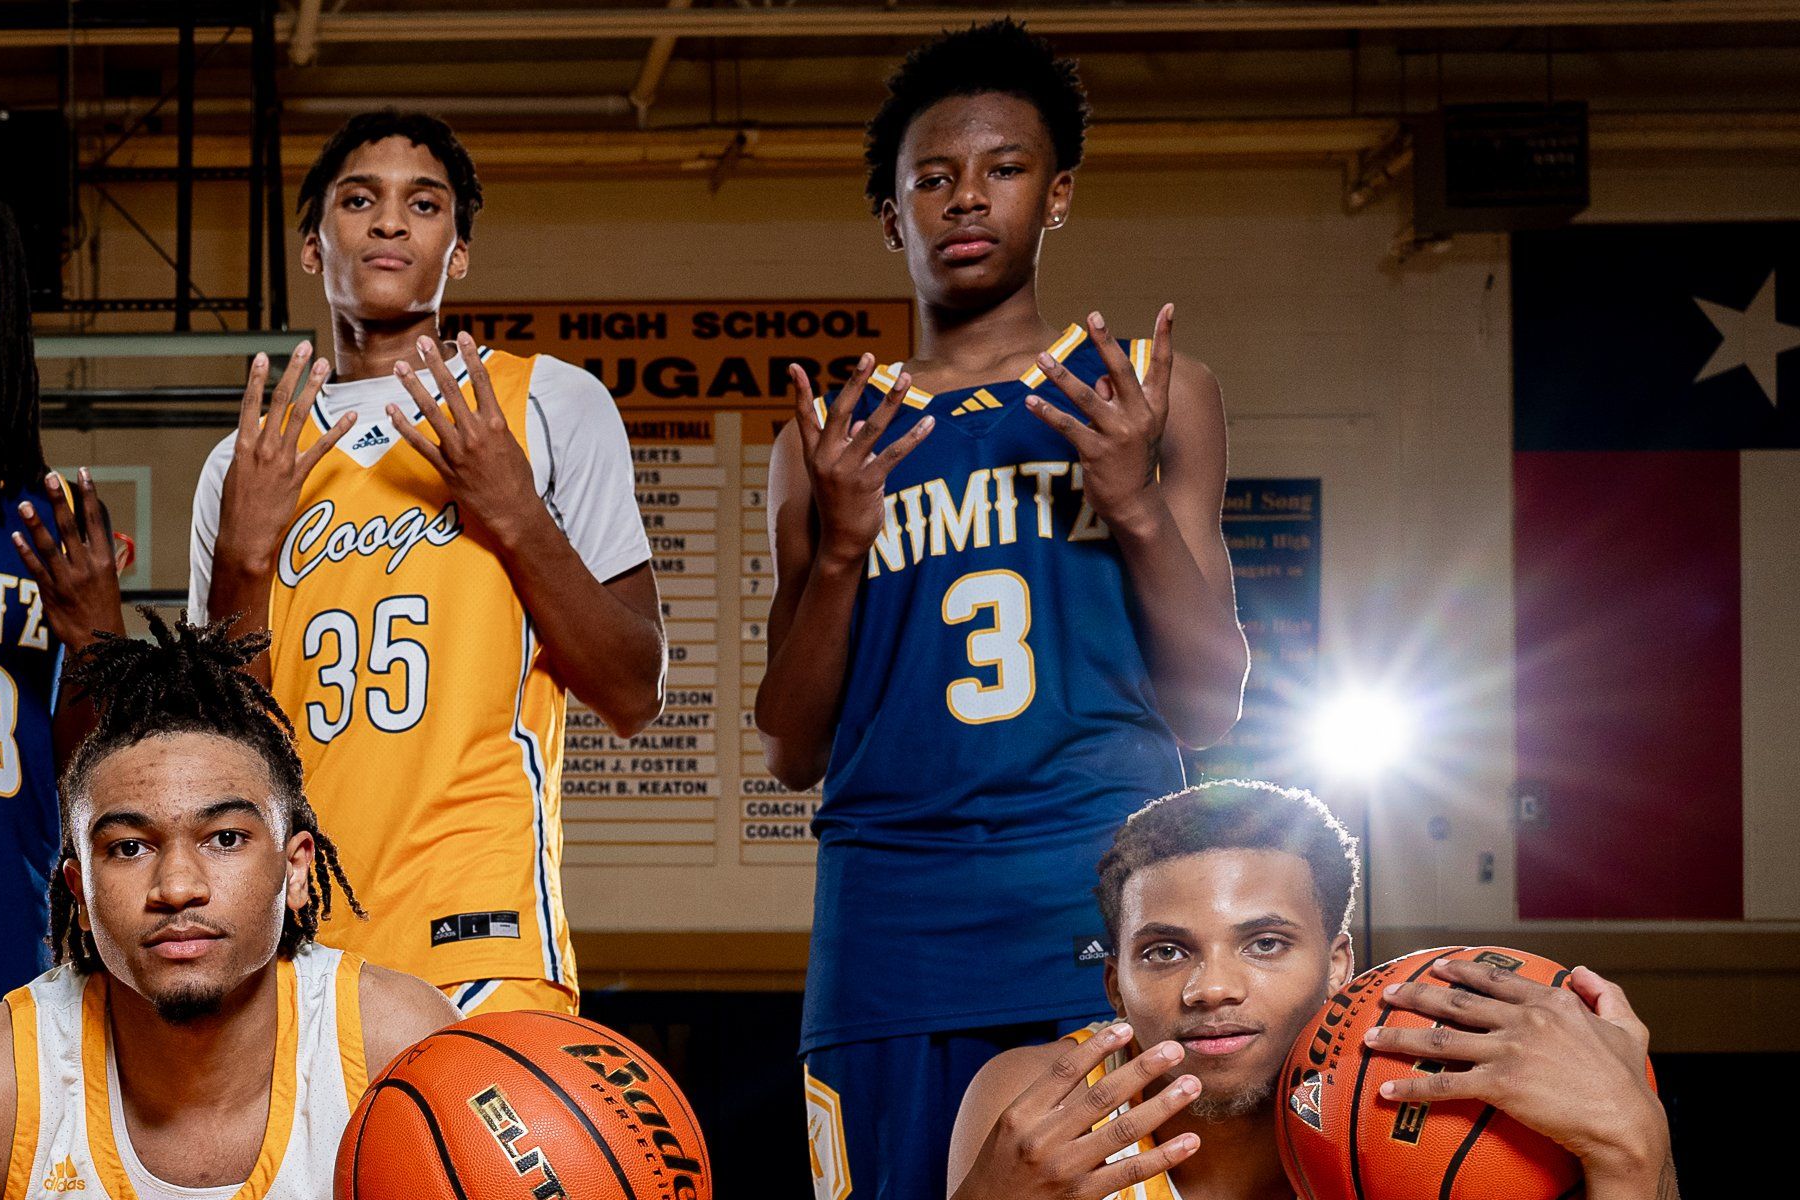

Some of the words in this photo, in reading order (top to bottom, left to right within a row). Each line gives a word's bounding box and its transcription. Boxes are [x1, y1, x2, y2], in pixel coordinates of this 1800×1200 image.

[560, 313, 667, 340] HIGH
[692, 311, 880, 338] SCHOOL
[352, 436, 390, 450] adidas
[277, 500, 464, 588] Coogs
[942, 569, 1036, 725] 3
[303, 594, 429, 744] 35
[630, 736, 696, 749] PALMER
[631, 758, 697, 771] FOSTER
[638, 781, 707, 794] KEATON
[746, 802, 805, 816] COACH
[746, 824, 805, 839] COACH
